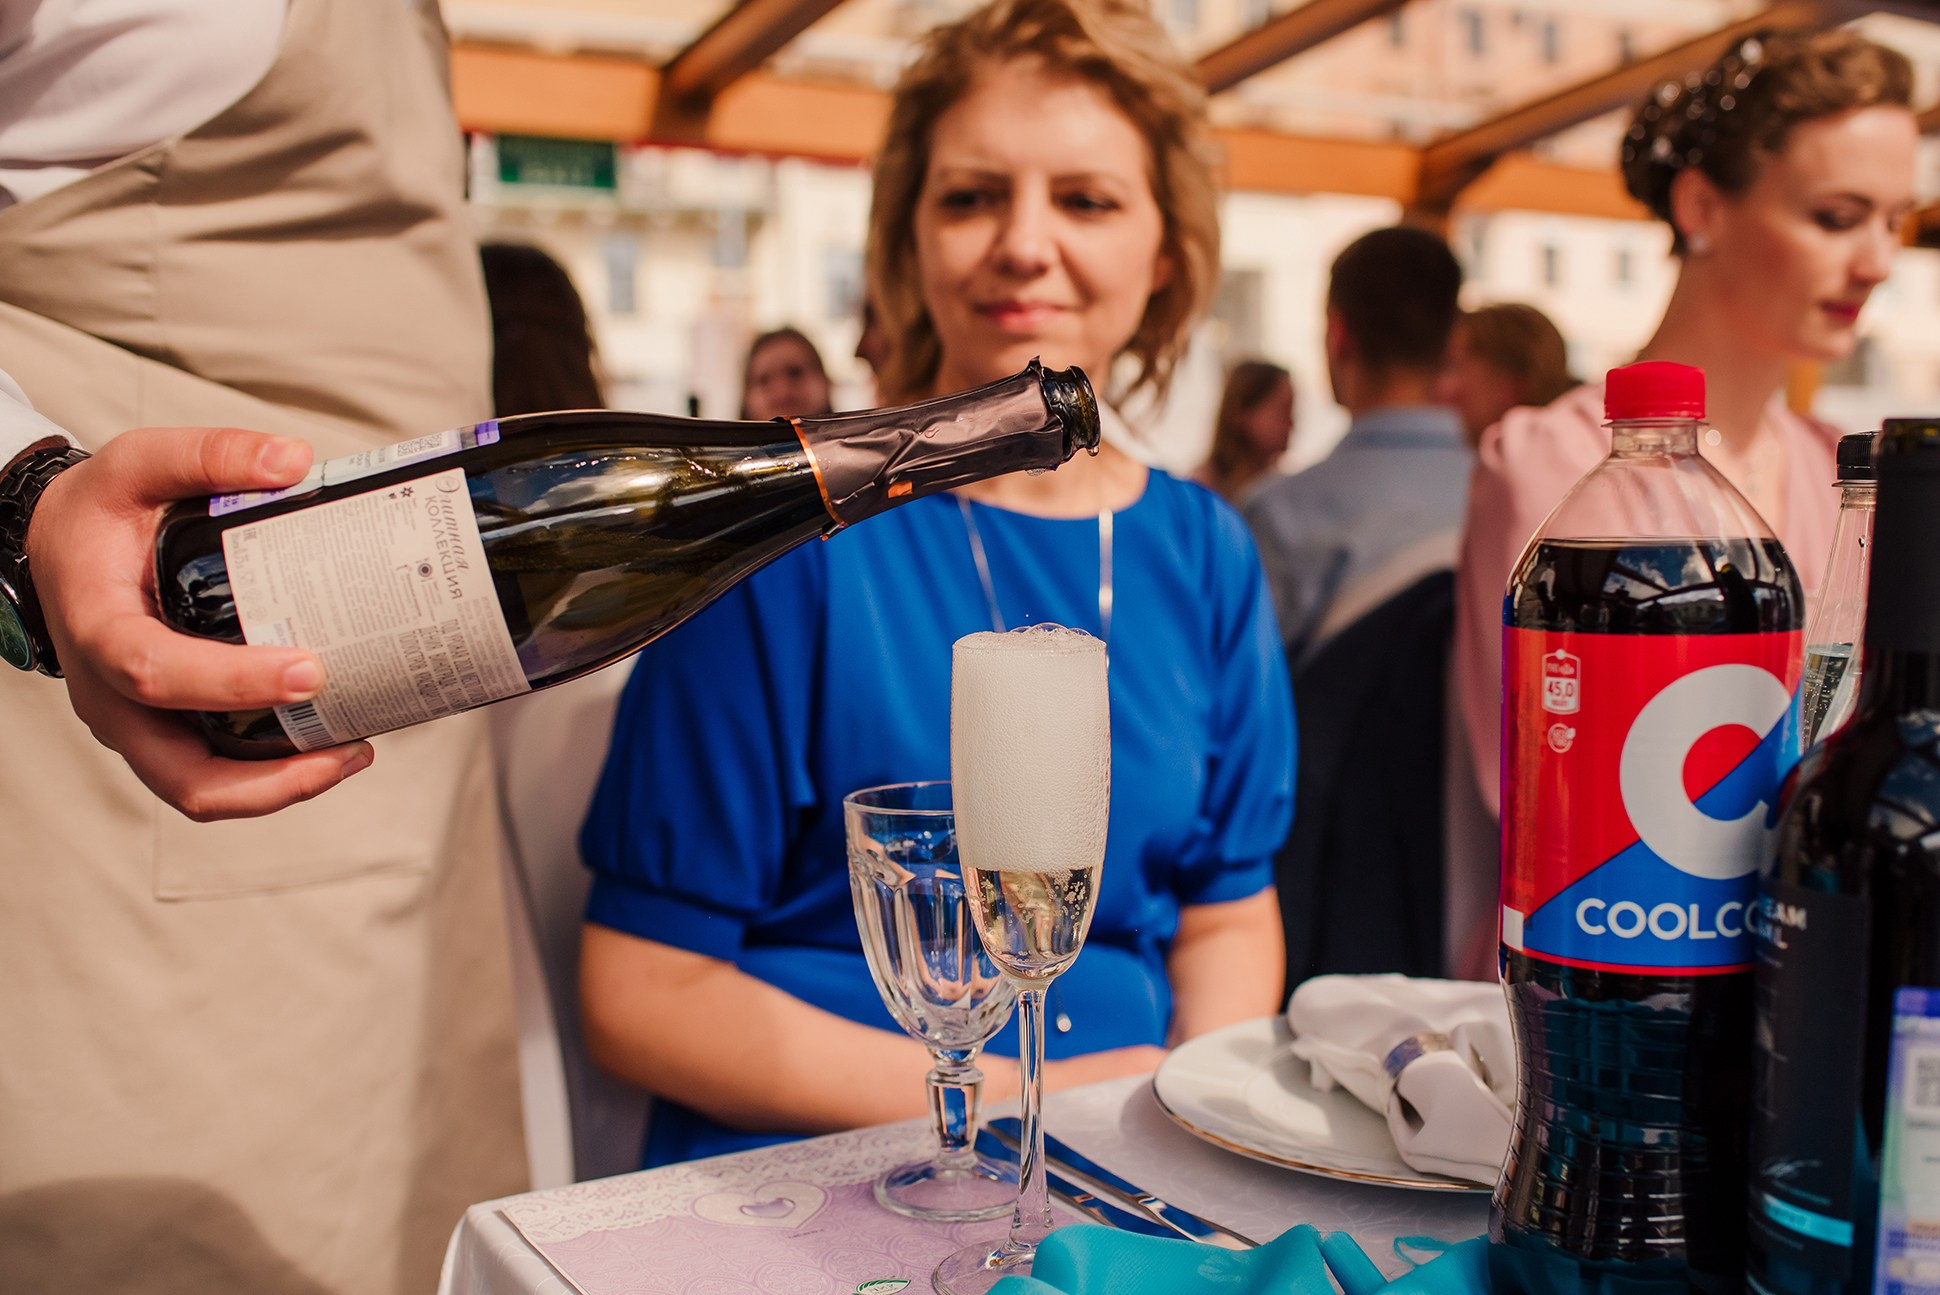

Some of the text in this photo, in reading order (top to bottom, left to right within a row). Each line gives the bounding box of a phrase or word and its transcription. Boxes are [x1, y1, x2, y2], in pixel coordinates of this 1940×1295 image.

[422, 495, 463, 600] КОЛЛЕКЦИЯ
[435, 476, 470, 571] Элитная
[396, 630, 428, 671] ПОЛУОСТРОВ
[443, 631, 470, 659] УРОЖАЯ
